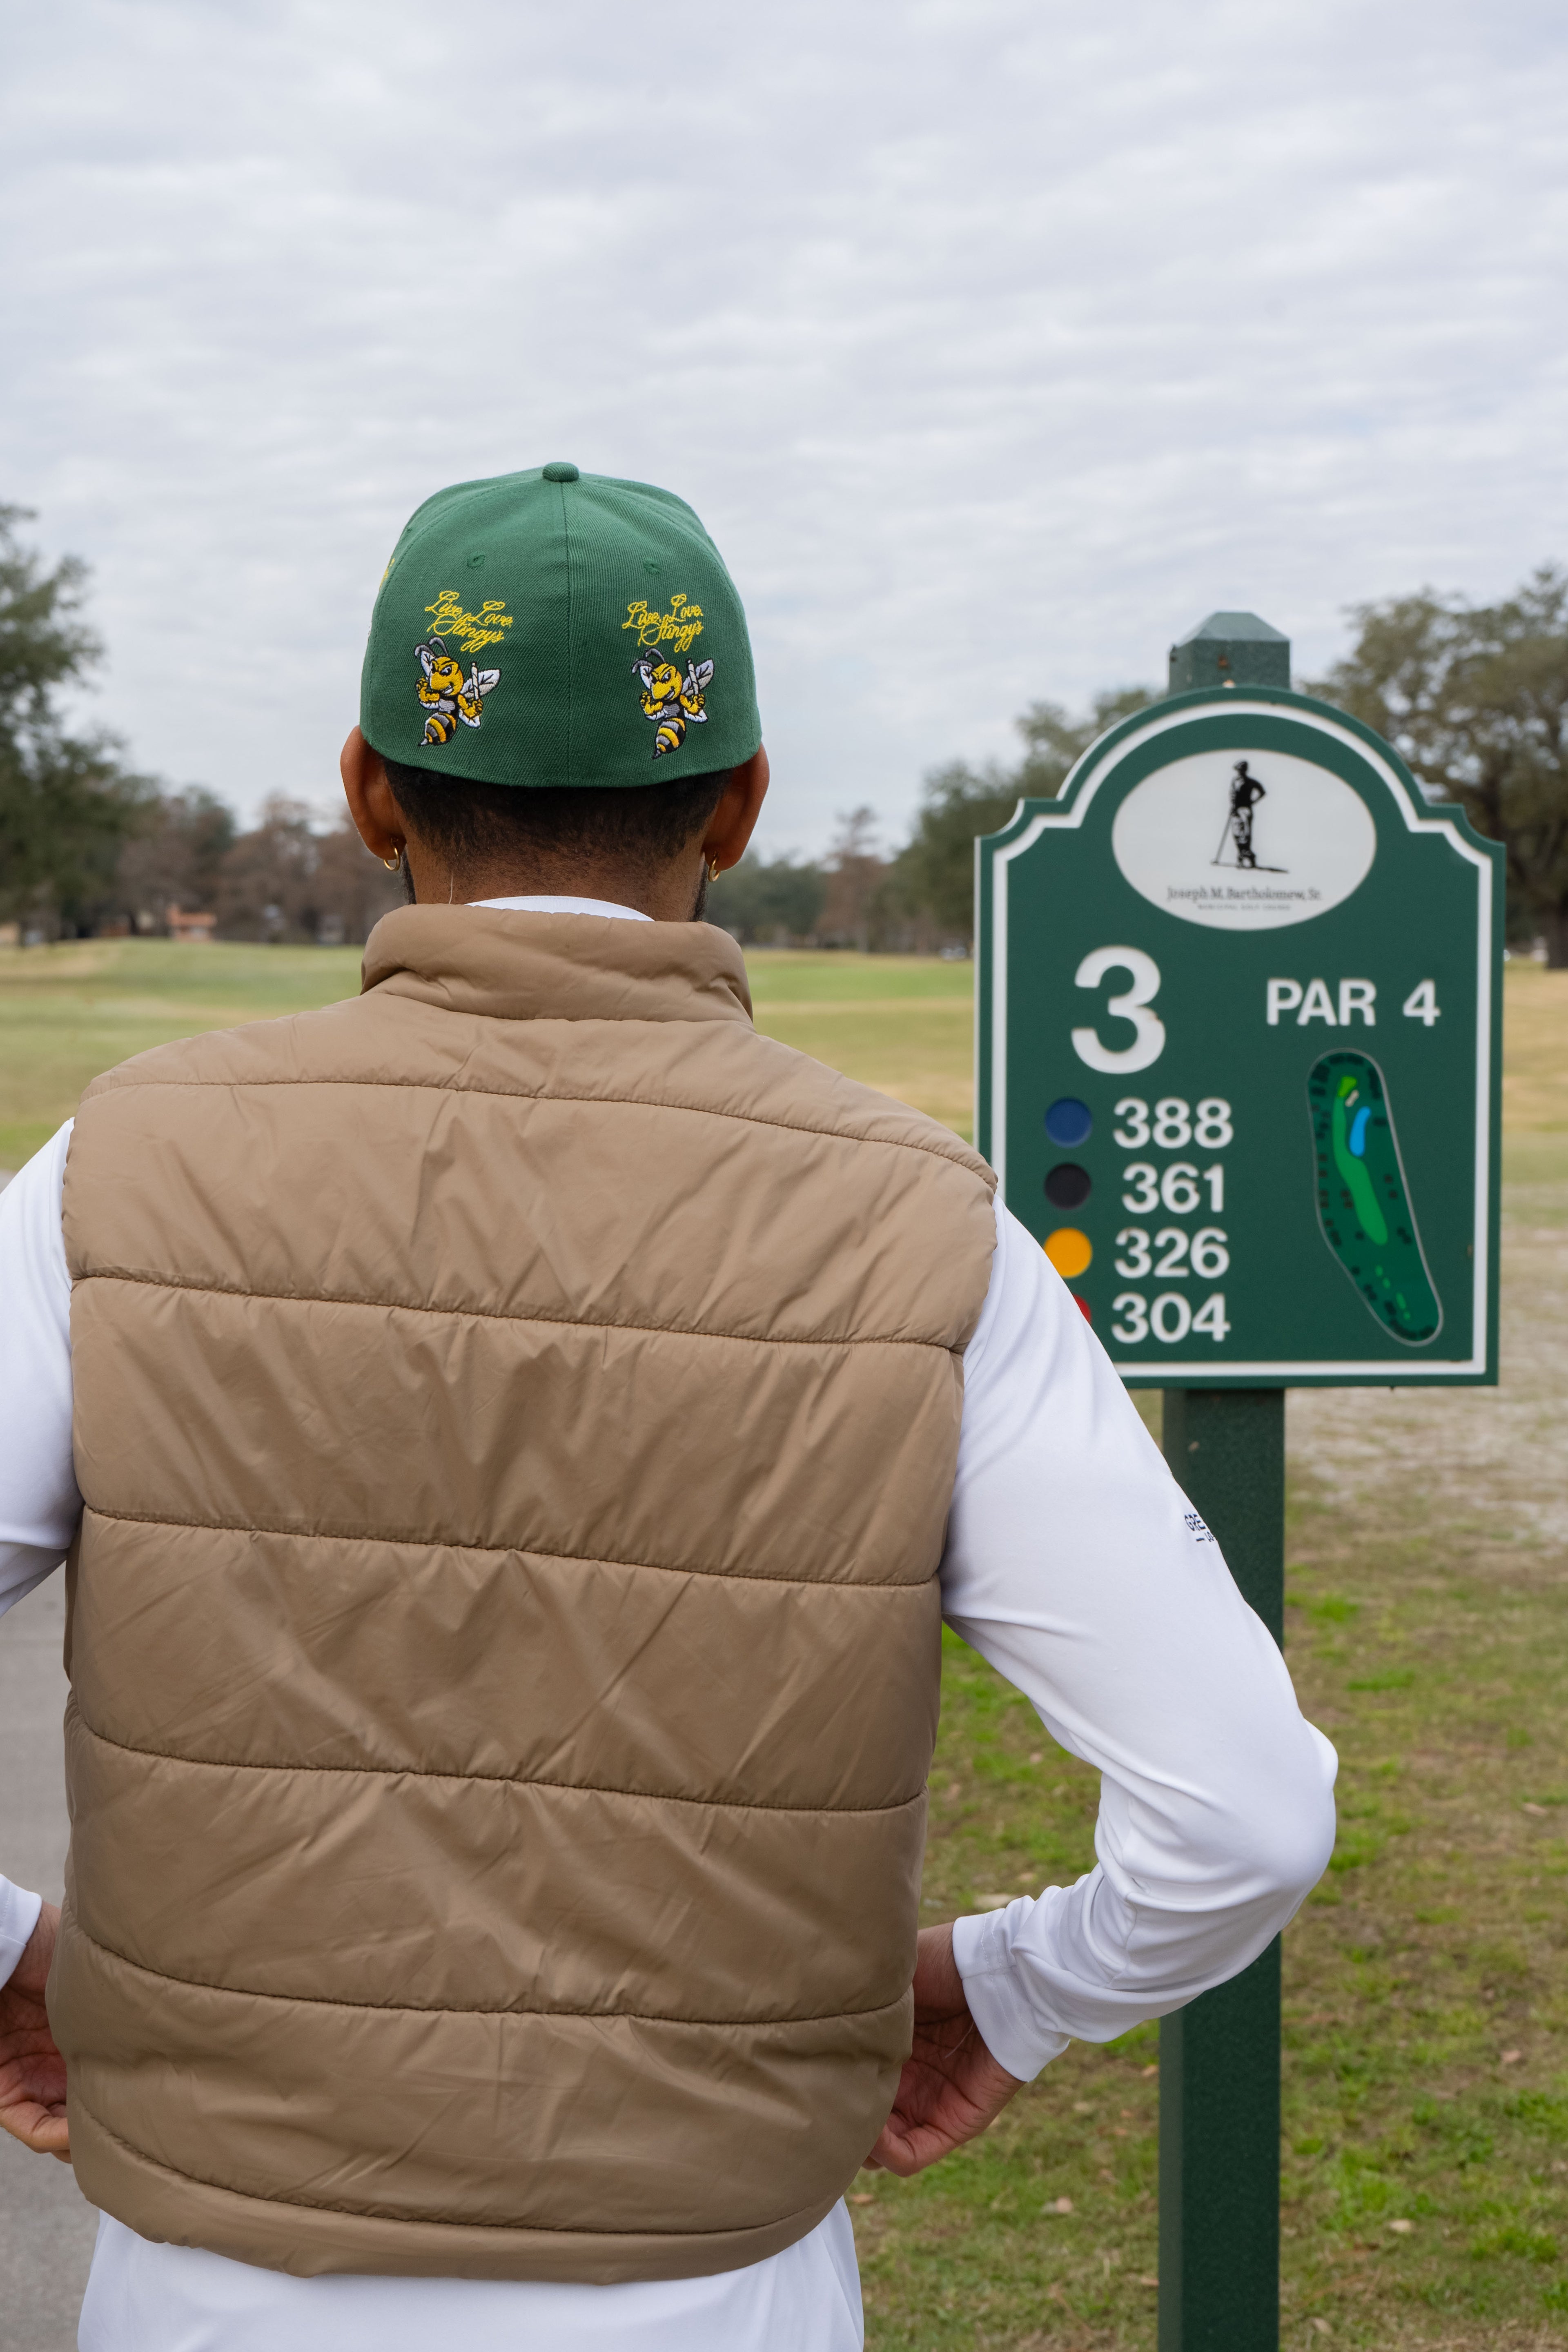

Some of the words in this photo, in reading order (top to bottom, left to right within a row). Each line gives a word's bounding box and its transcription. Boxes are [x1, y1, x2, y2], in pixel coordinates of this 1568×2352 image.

[1167, 886, 1207, 903] Joseph
[1071, 945, 1166, 1074] 3
[1266, 978, 1376, 1026] PAR
[1403, 980, 1441, 1027] 4
[1114, 1098, 1234, 1149] 388
[1123, 1163, 1224, 1214] 361
[1115, 1227, 1230, 1279] 326
[1111, 1293, 1231, 1344] 304
